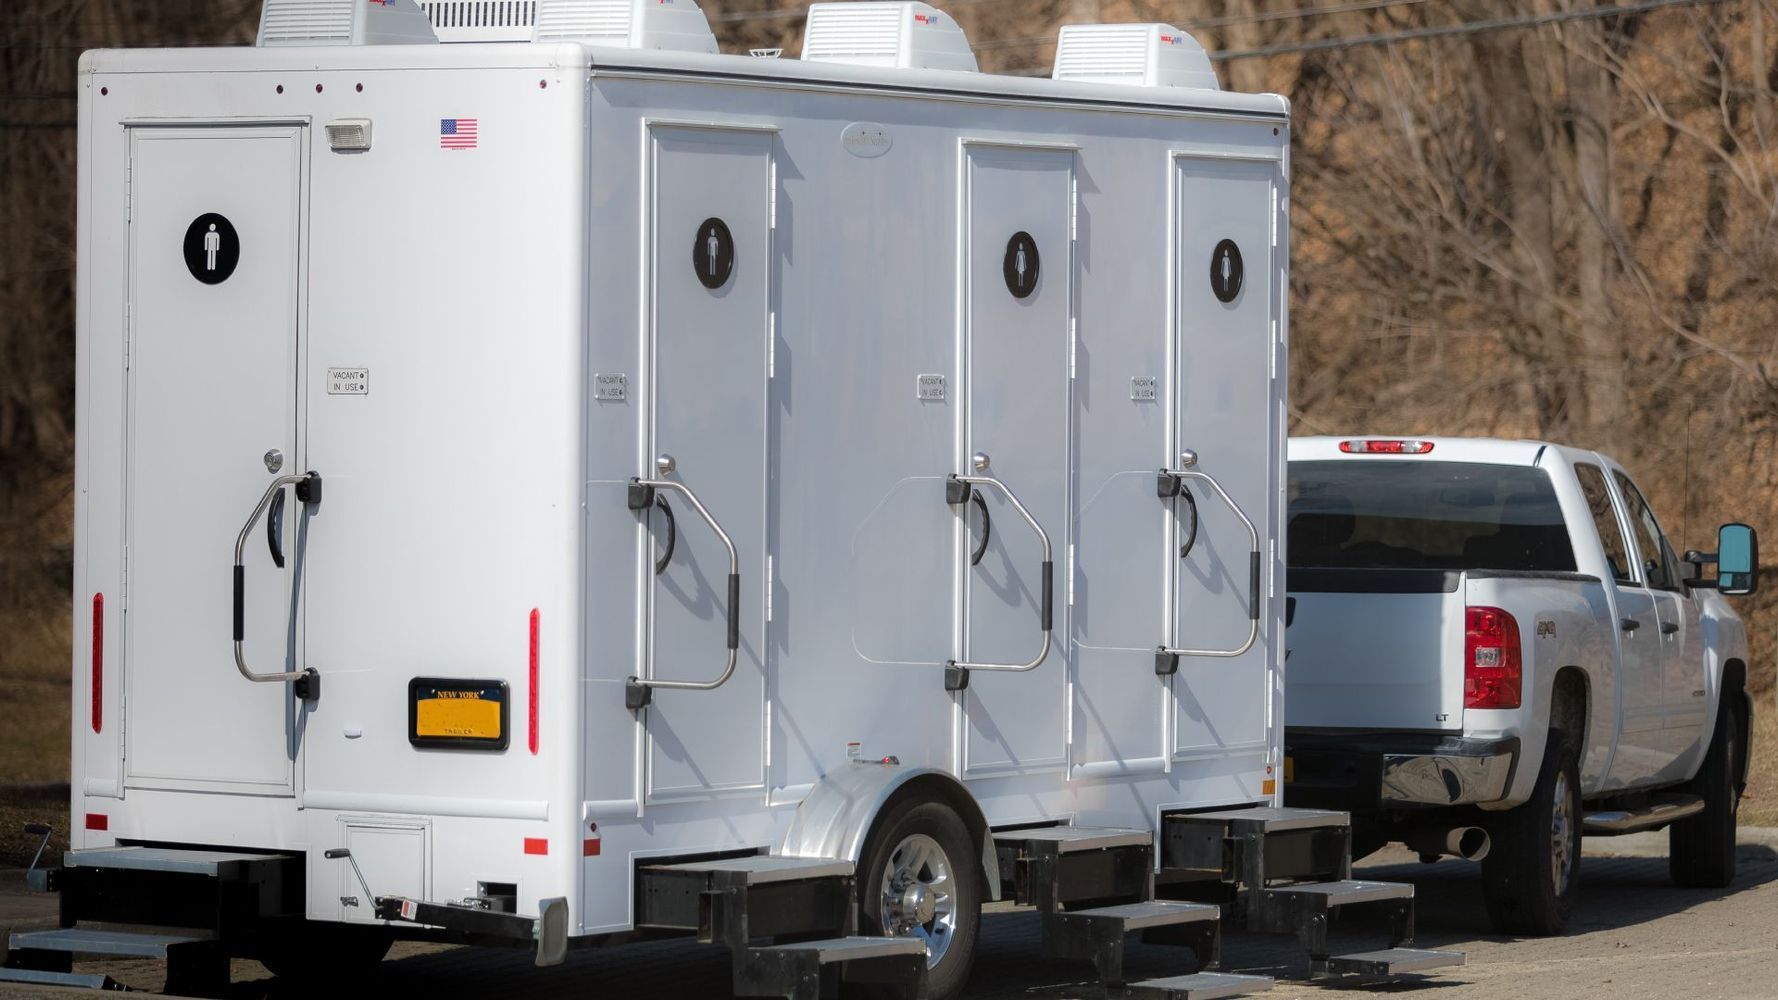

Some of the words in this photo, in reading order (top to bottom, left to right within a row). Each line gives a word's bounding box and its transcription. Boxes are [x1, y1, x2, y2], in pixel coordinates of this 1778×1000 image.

[333, 371, 359, 380] VACANT
[333, 383, 341, 391] IN
[344, 383, 359, 391] USE
[437, 691, 457, 699] NEW
[459, 691, 480, 700] YORK
[1435, 713, 1449, 721] LT
